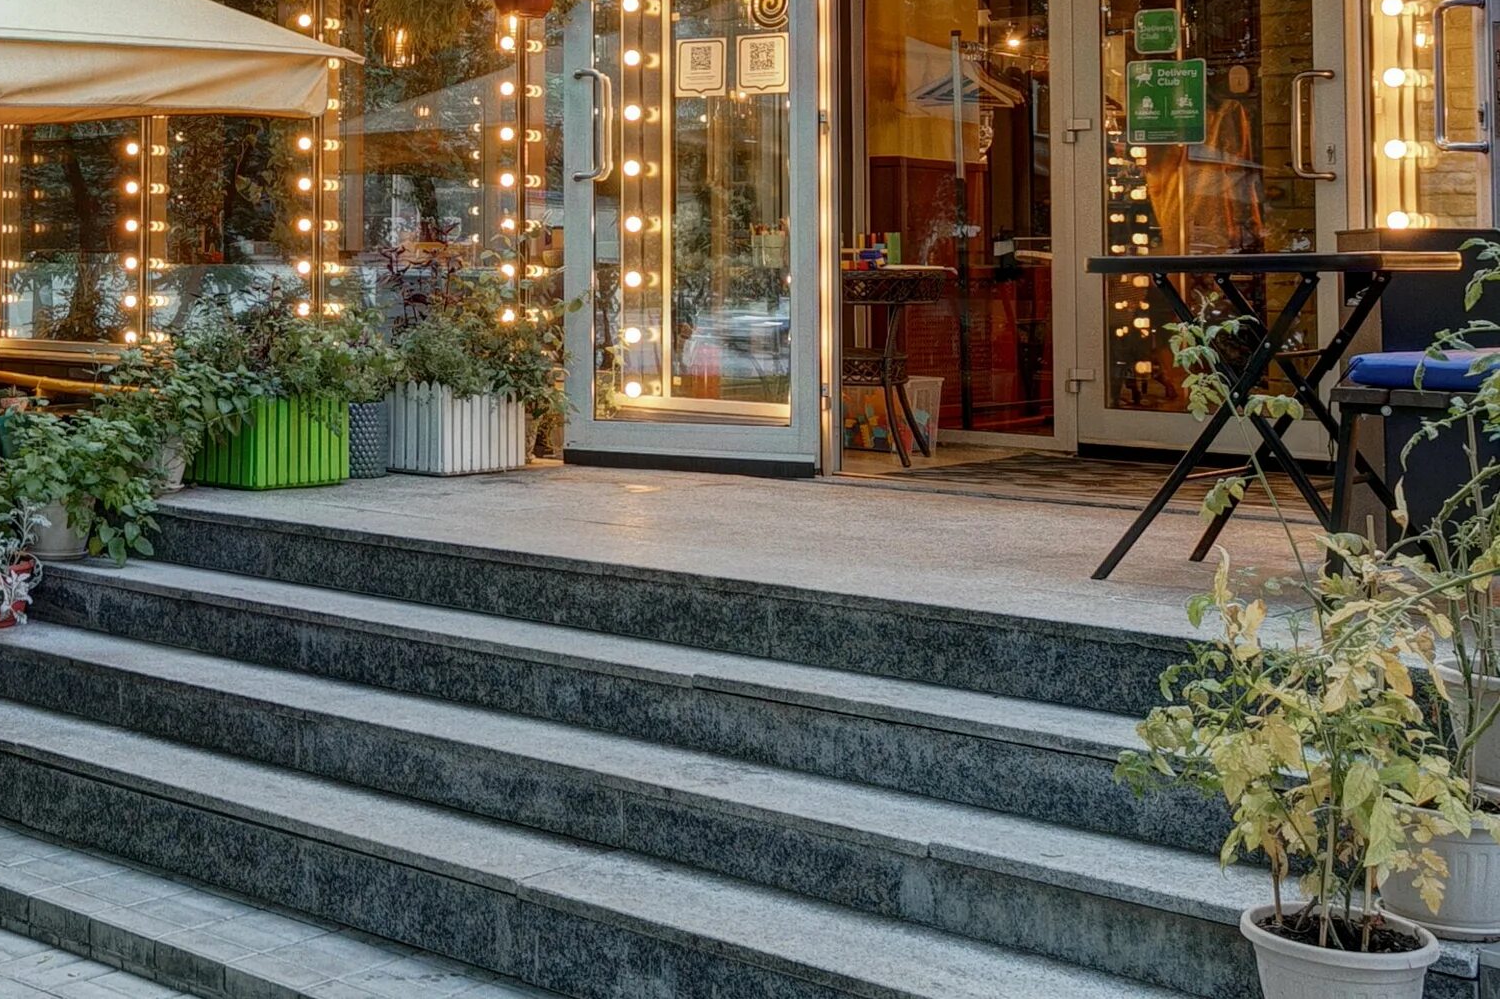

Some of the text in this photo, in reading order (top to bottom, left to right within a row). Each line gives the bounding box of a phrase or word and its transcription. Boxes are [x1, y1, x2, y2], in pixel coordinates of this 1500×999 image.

[1140, 25, 1174, 33] Delivery
[1140, 32, 1160, 40] Club
[1157, 69, 1197, 78] Delivery
[1157, 78, 1180, 86] Club
